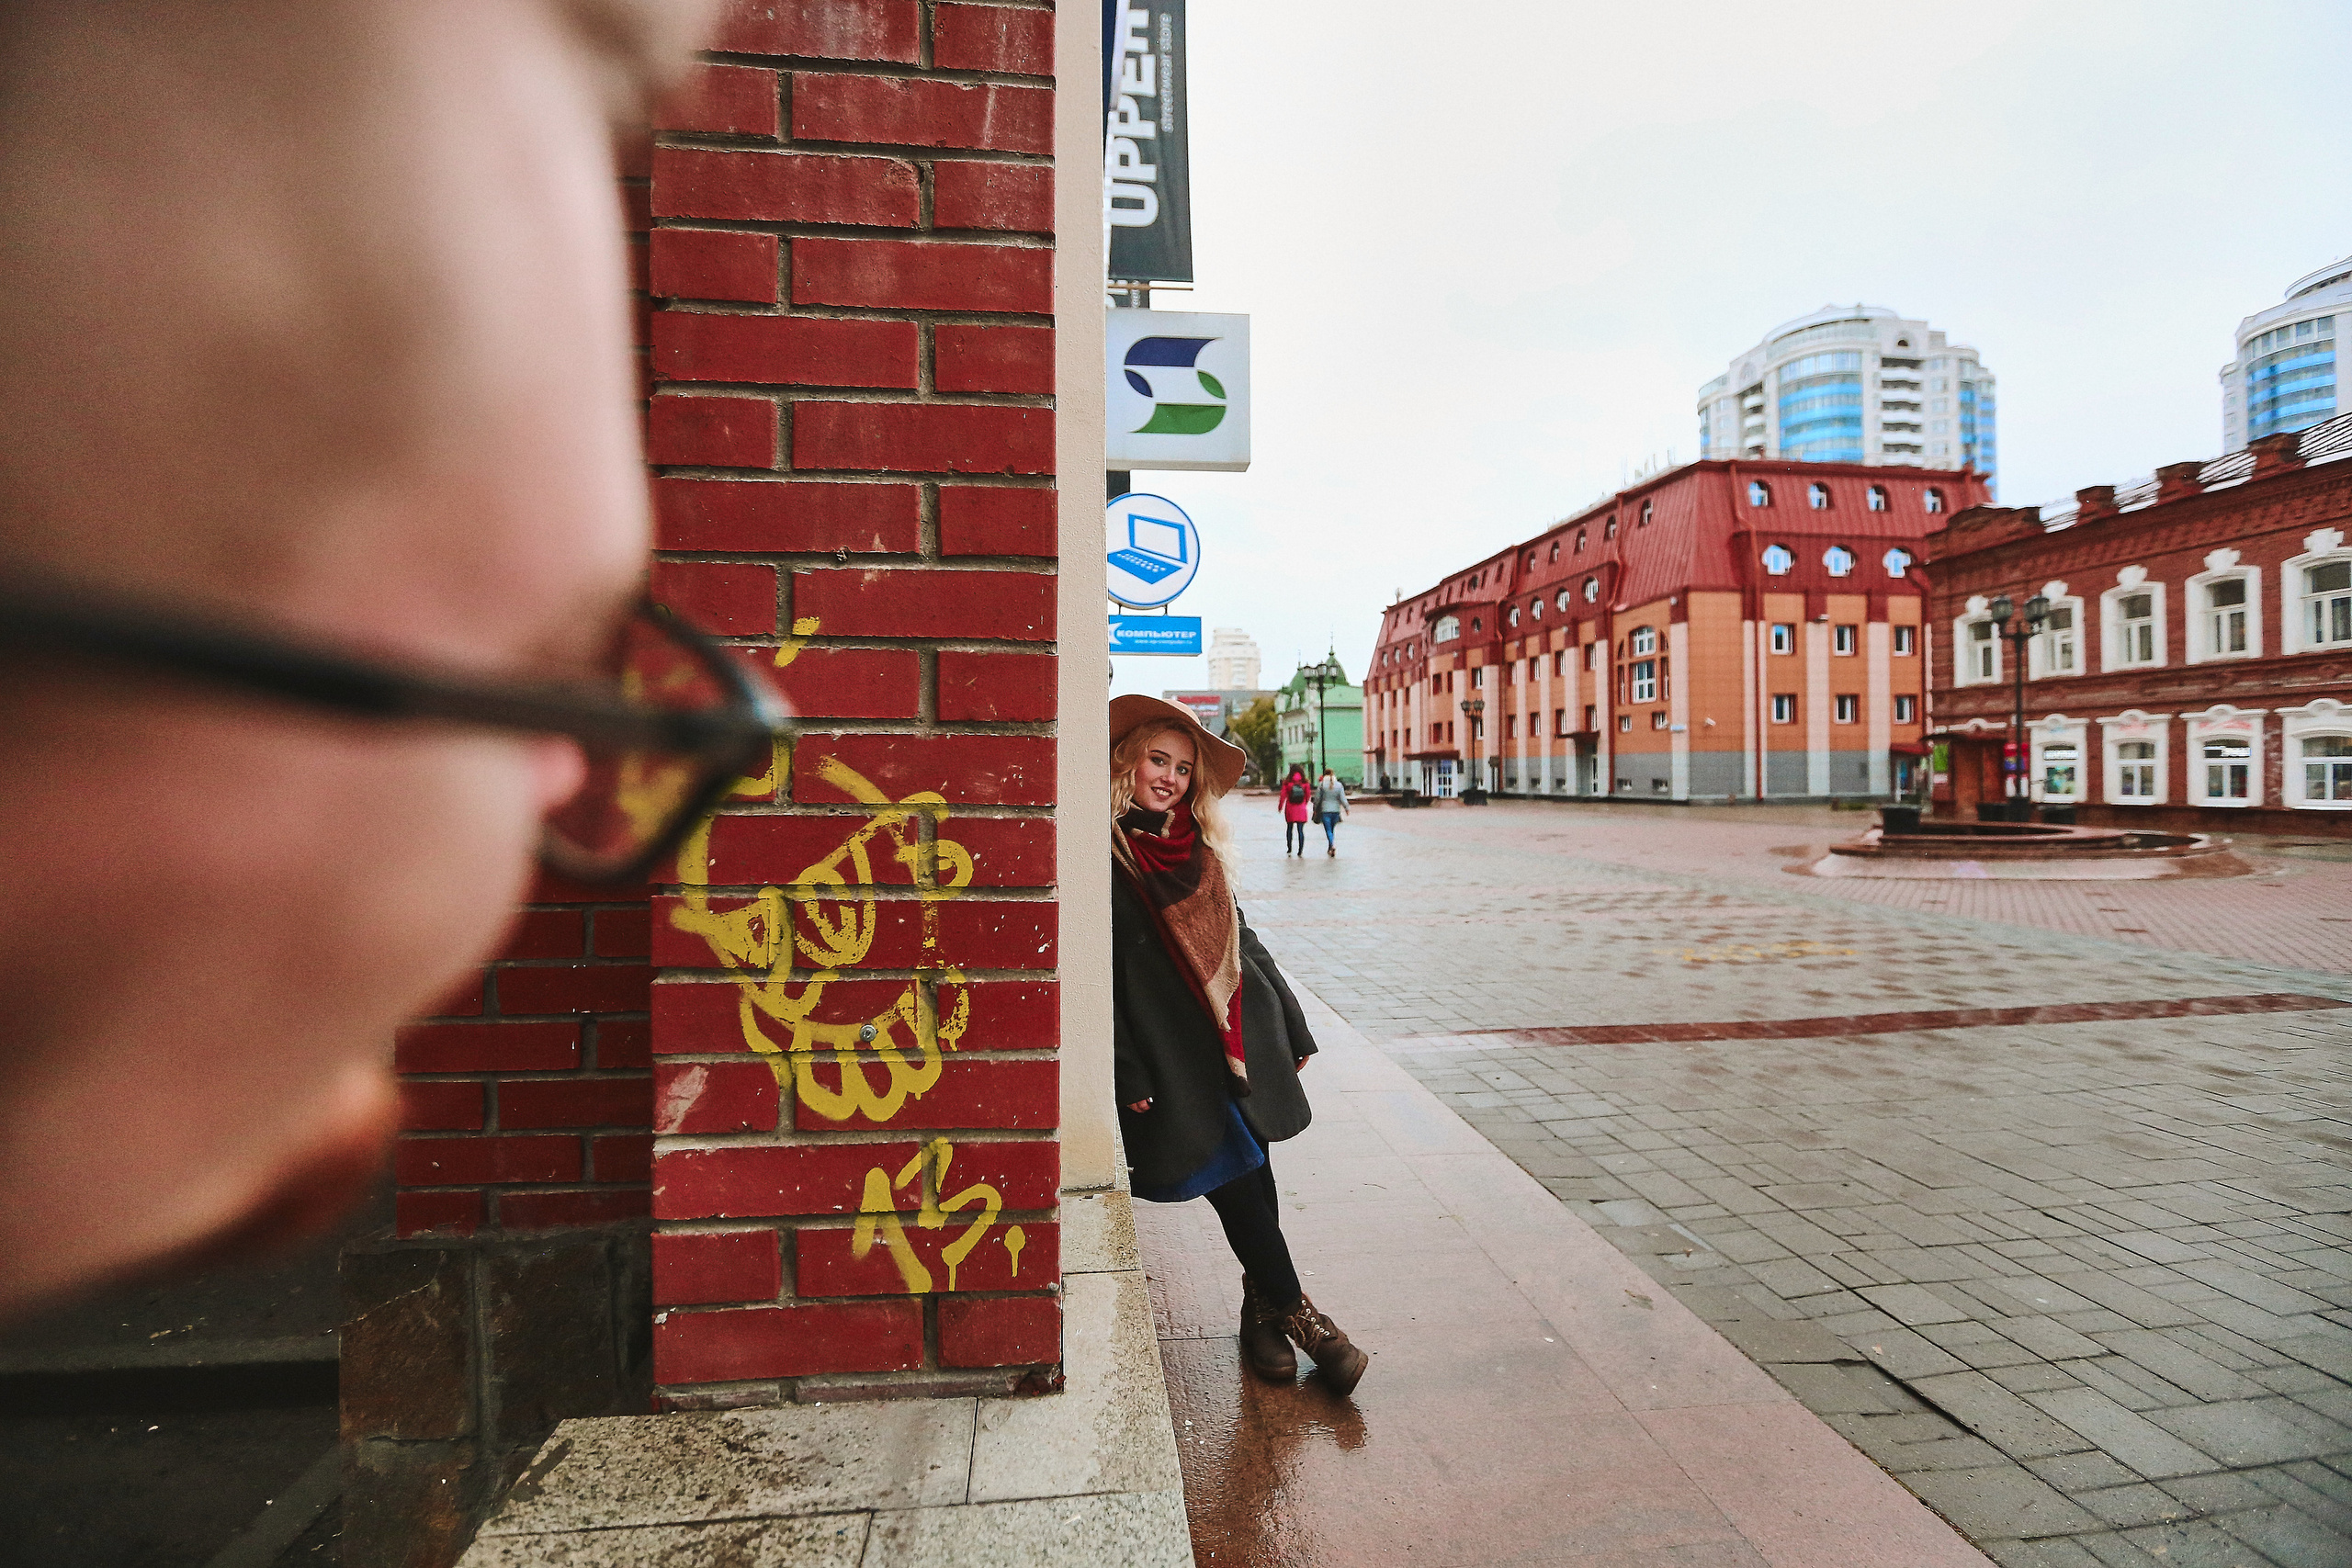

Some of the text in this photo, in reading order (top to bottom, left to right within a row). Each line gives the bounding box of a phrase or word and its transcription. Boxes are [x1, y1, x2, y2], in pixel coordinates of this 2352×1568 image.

[1159, 13, 1174, 133] streetwear store
[1116, 630, 1197, 638] КОМПЬЮТЕР
